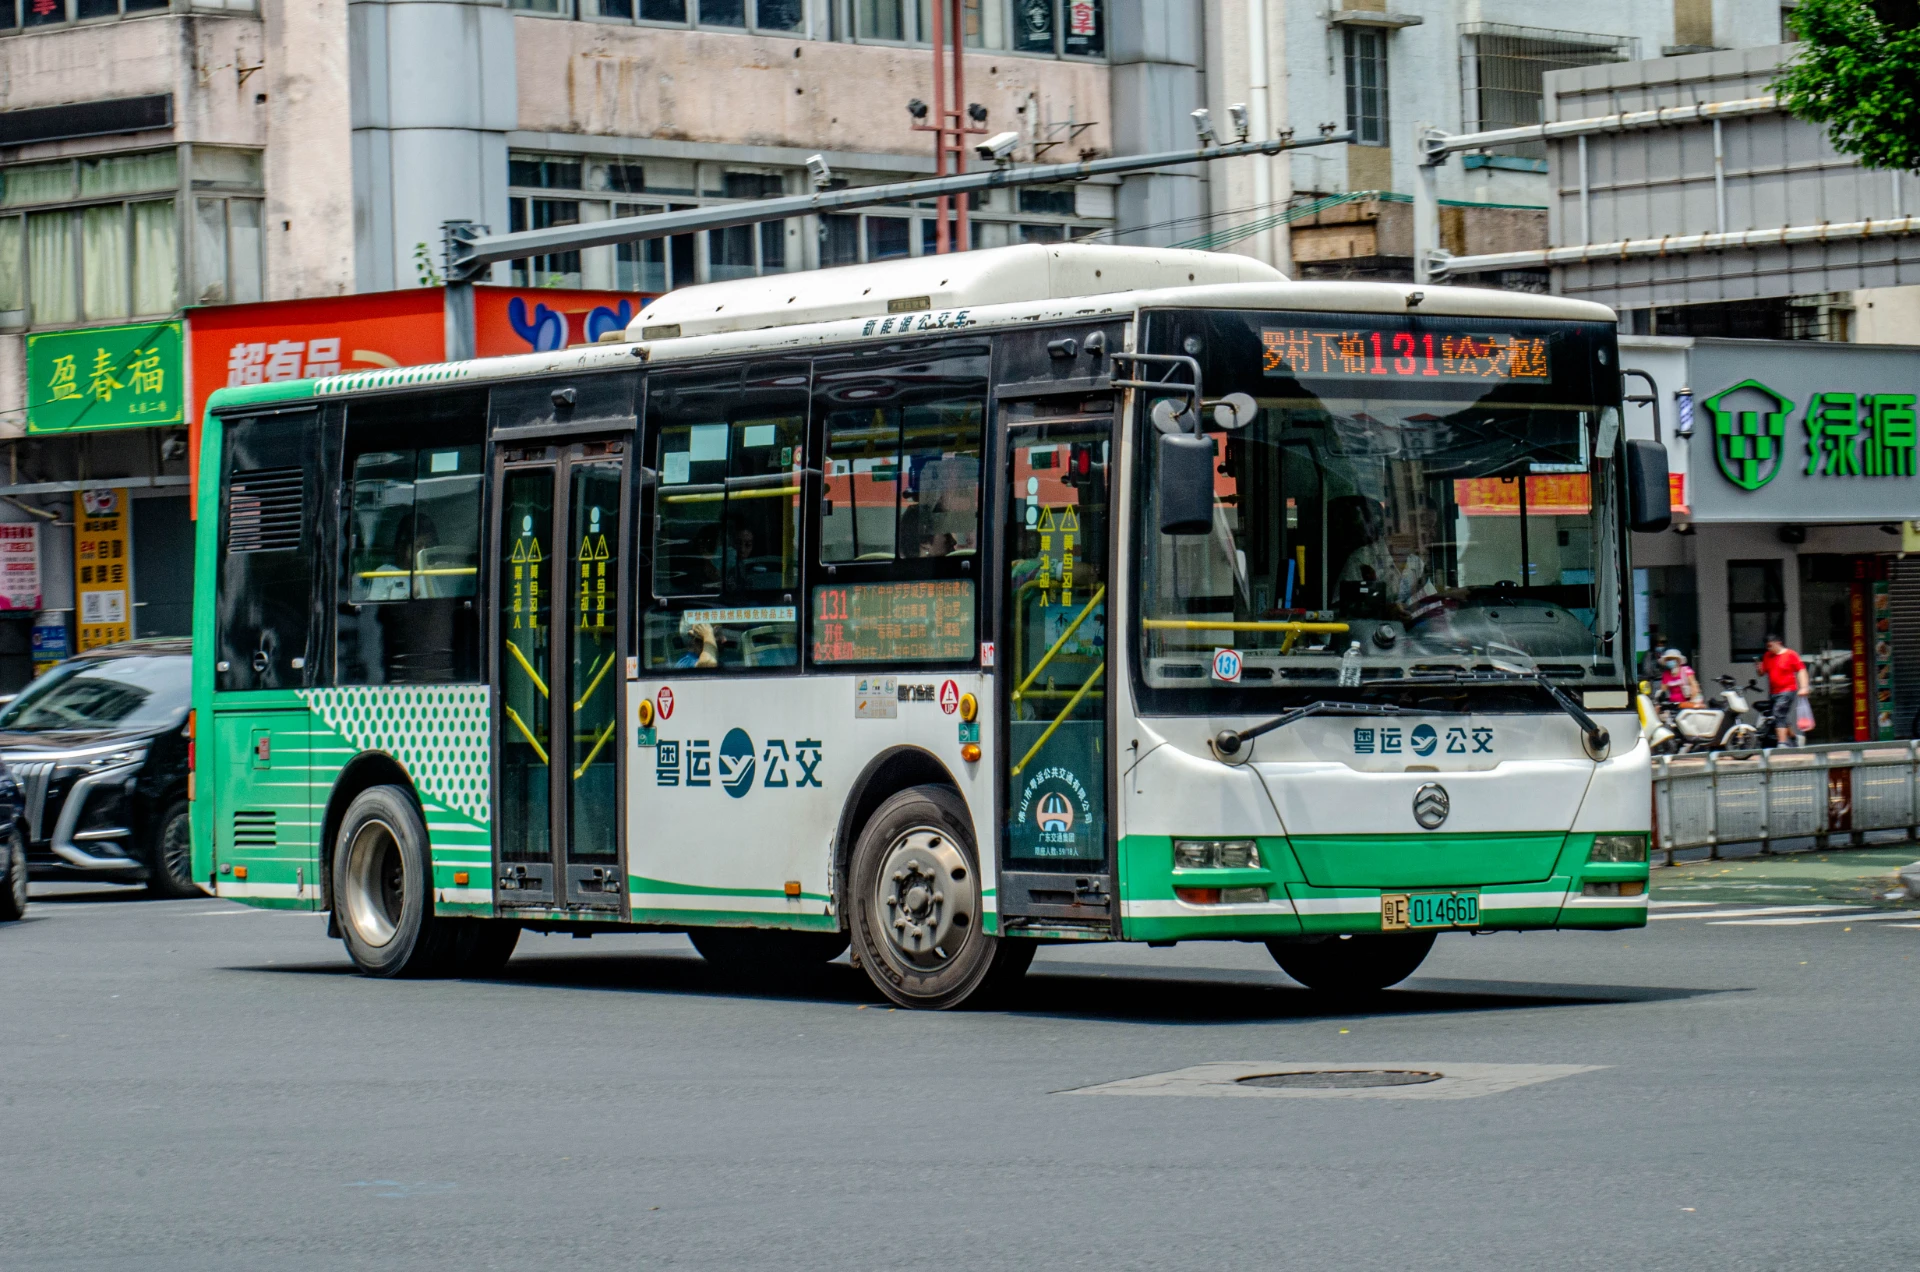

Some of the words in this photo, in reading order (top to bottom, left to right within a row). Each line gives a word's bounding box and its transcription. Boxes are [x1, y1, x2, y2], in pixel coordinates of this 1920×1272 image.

[862, 310, 971, 337] 新能源公交车
[227, 337, 341, 388] 超有品
[1263, 330, 1365, 374] 罗村下柏
[1370, 332, 1439, 377] 131
[46, 347, 165, 403] 盈春福
[1805, 392, 1917, 476] 绿源
[687, 609, 794, 621] 严禁携带易燃易爆危险品上车
[819, 590, 848, 620] 131
[1219, 655, 1237, 675] 131
[945, 686, 954, 701] 上
[945, 704, 954, 714] UP
[1354, 727, 1402, 754] 粤运
[1446, 727, 1494, 754] 公交
[656, 739, 711, 787] 粤运
[763, 738, 822, 788] 公交
[1018, 767, 1093, 824] 佛山市粤运公共交通有限公司
[1039, 832, 1075, 843] 广东交通集团
